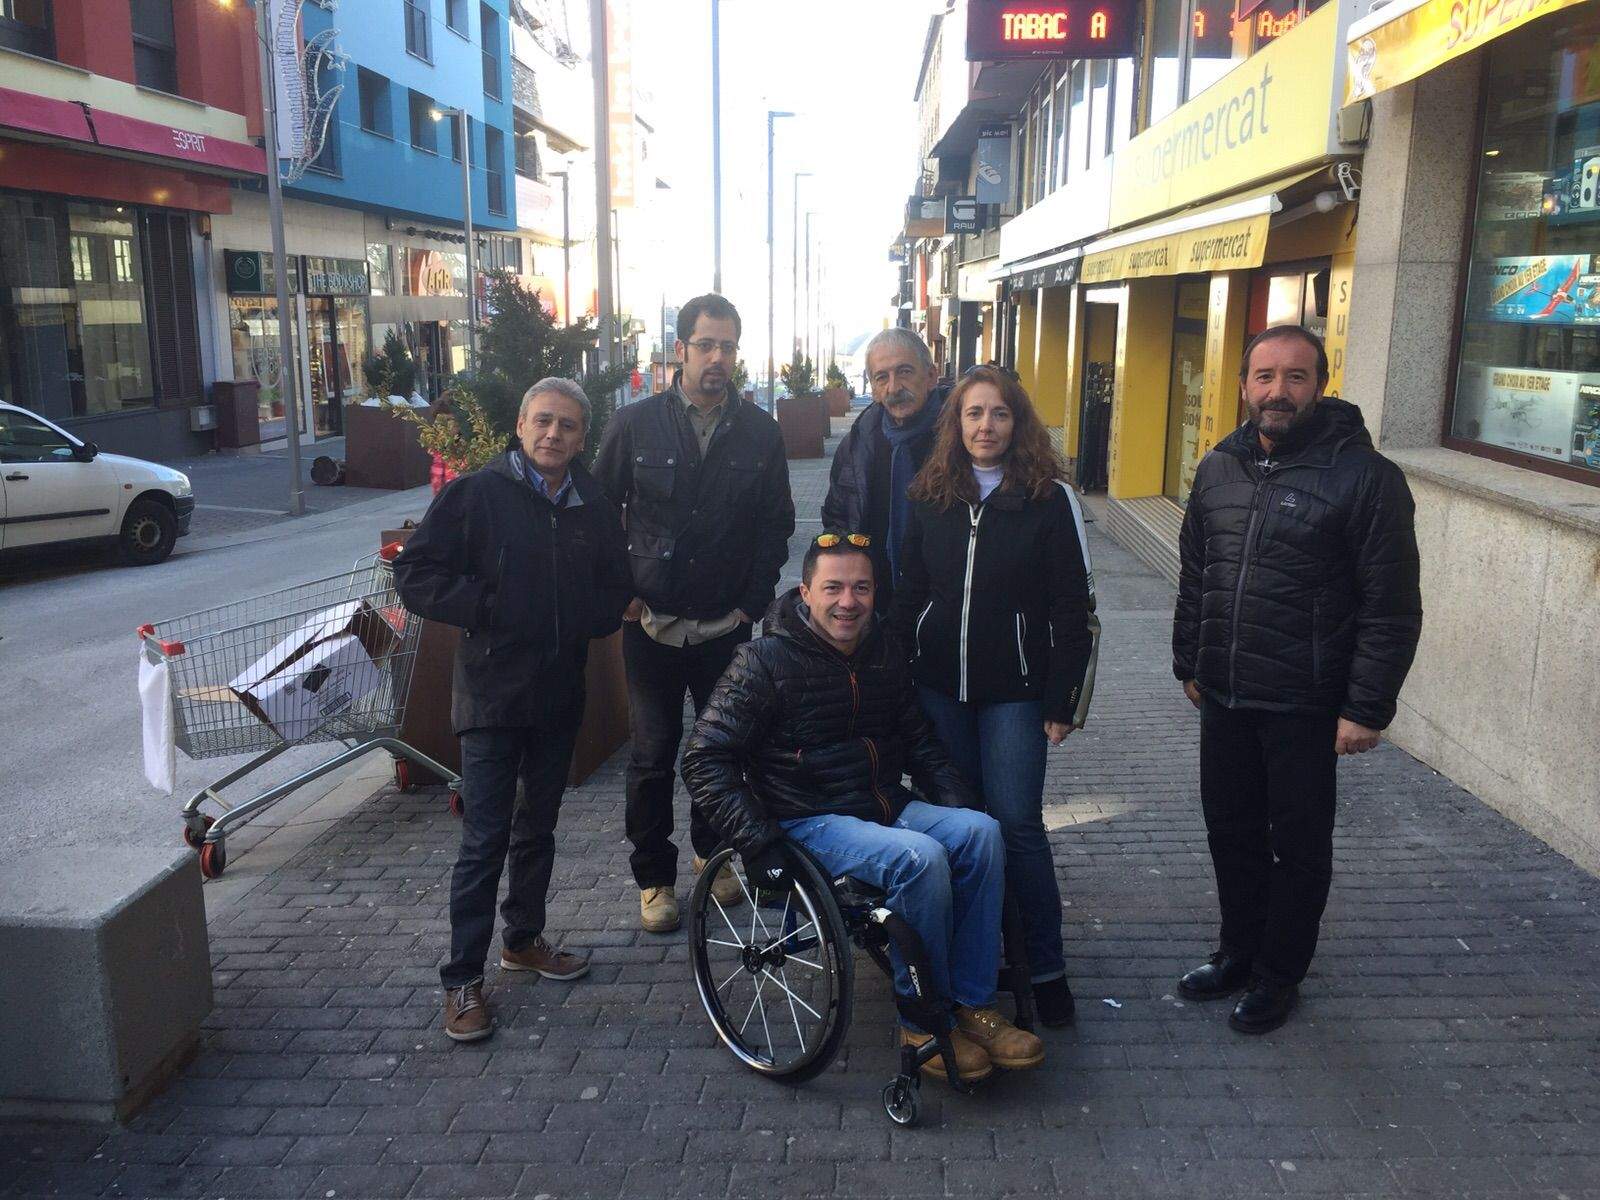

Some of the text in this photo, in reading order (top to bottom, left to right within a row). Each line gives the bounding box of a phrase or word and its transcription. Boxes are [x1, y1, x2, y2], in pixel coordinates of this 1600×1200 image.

[1002, 12, 1107, 39] TABAC A
[1132, 62, 1272, 184] permercat
[172, 130, 205, 152] ESPRIT
[953, 222, 976, 230] RAW
[1190, 227, 1252, 270] supermercat
[312, 273, 327, 288] THE
